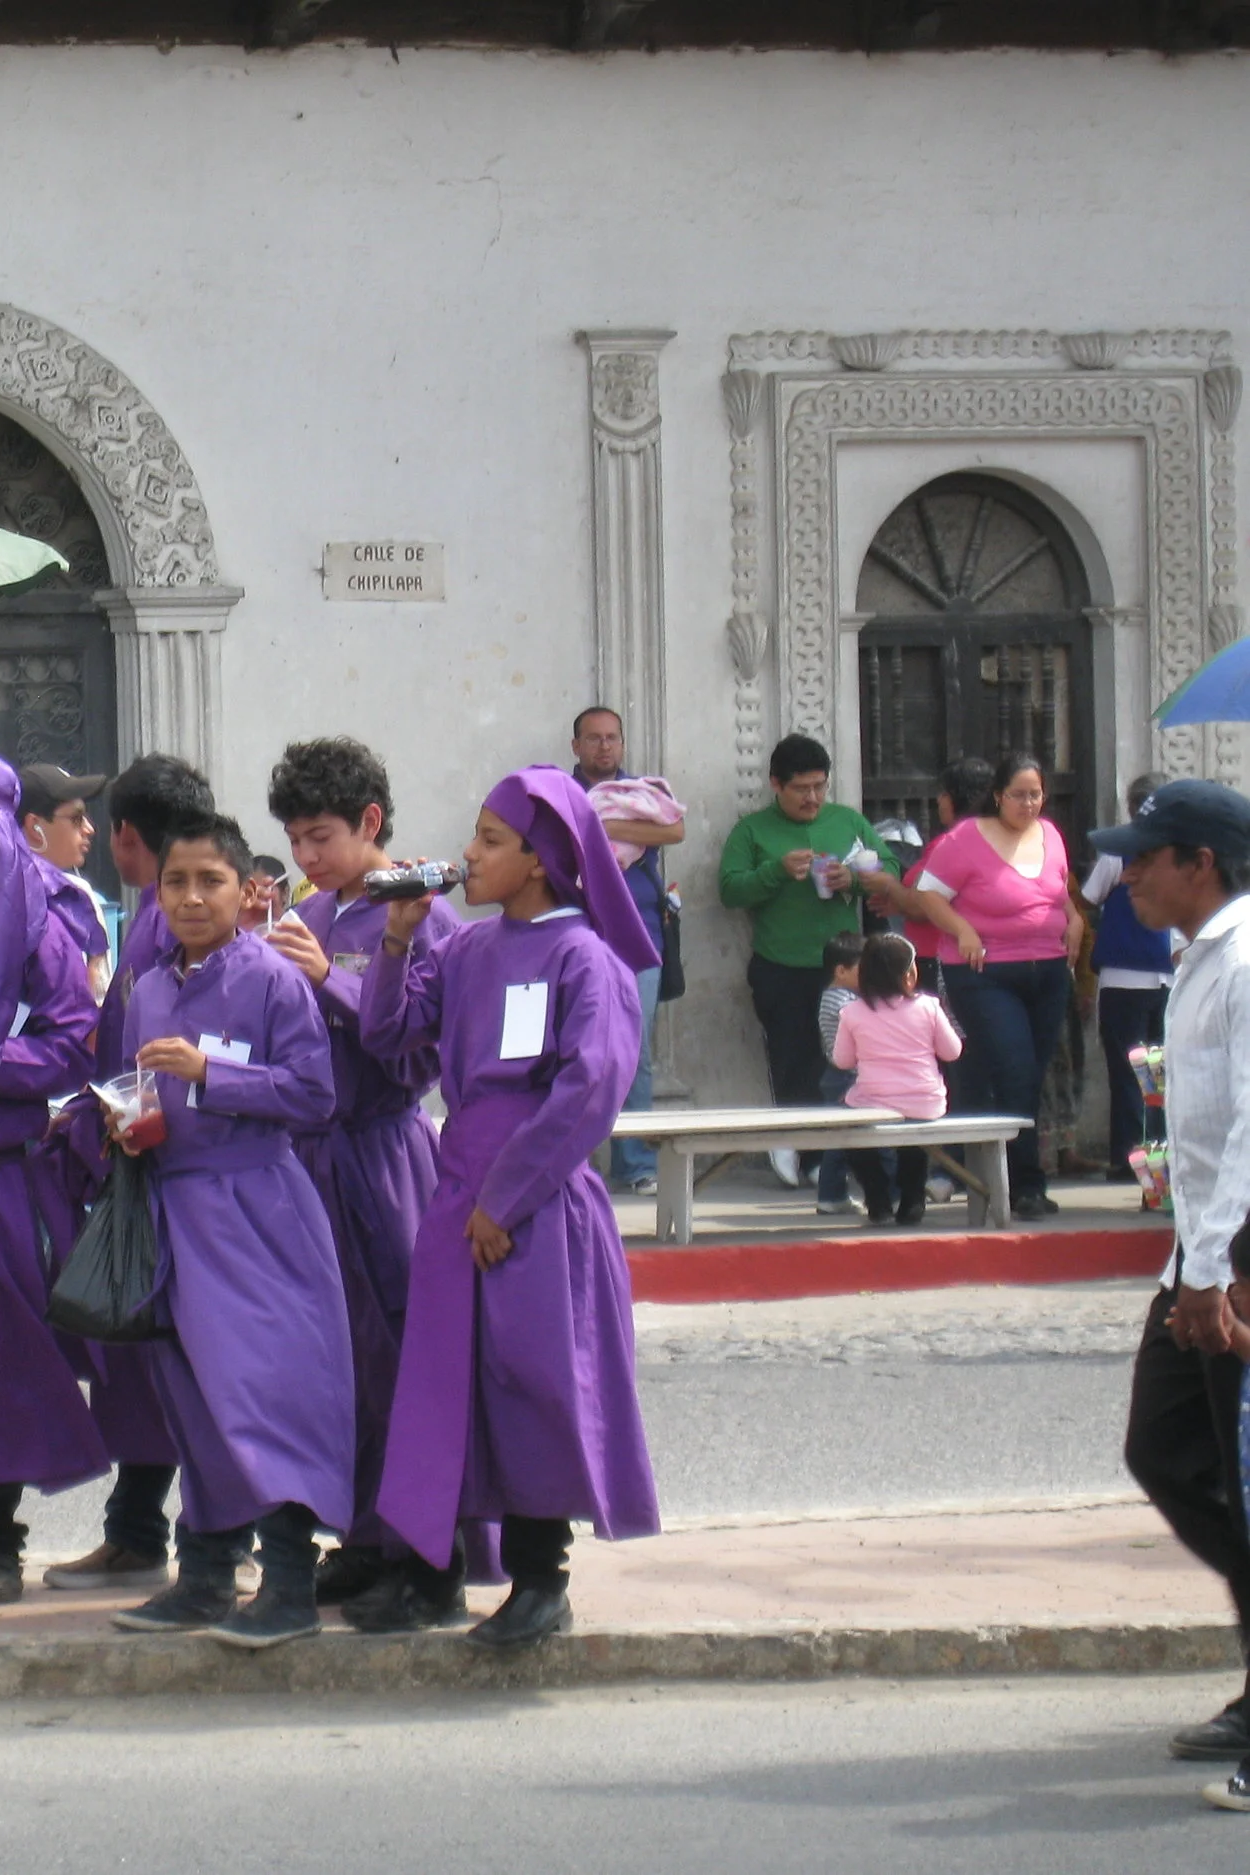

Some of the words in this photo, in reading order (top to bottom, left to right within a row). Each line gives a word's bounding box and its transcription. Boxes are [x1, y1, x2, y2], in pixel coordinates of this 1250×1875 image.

[353, 545, 395, 562] CALLE
[405, 546, 425, 561] DE
[347, 575, 422, 591] CHIPILAPA
